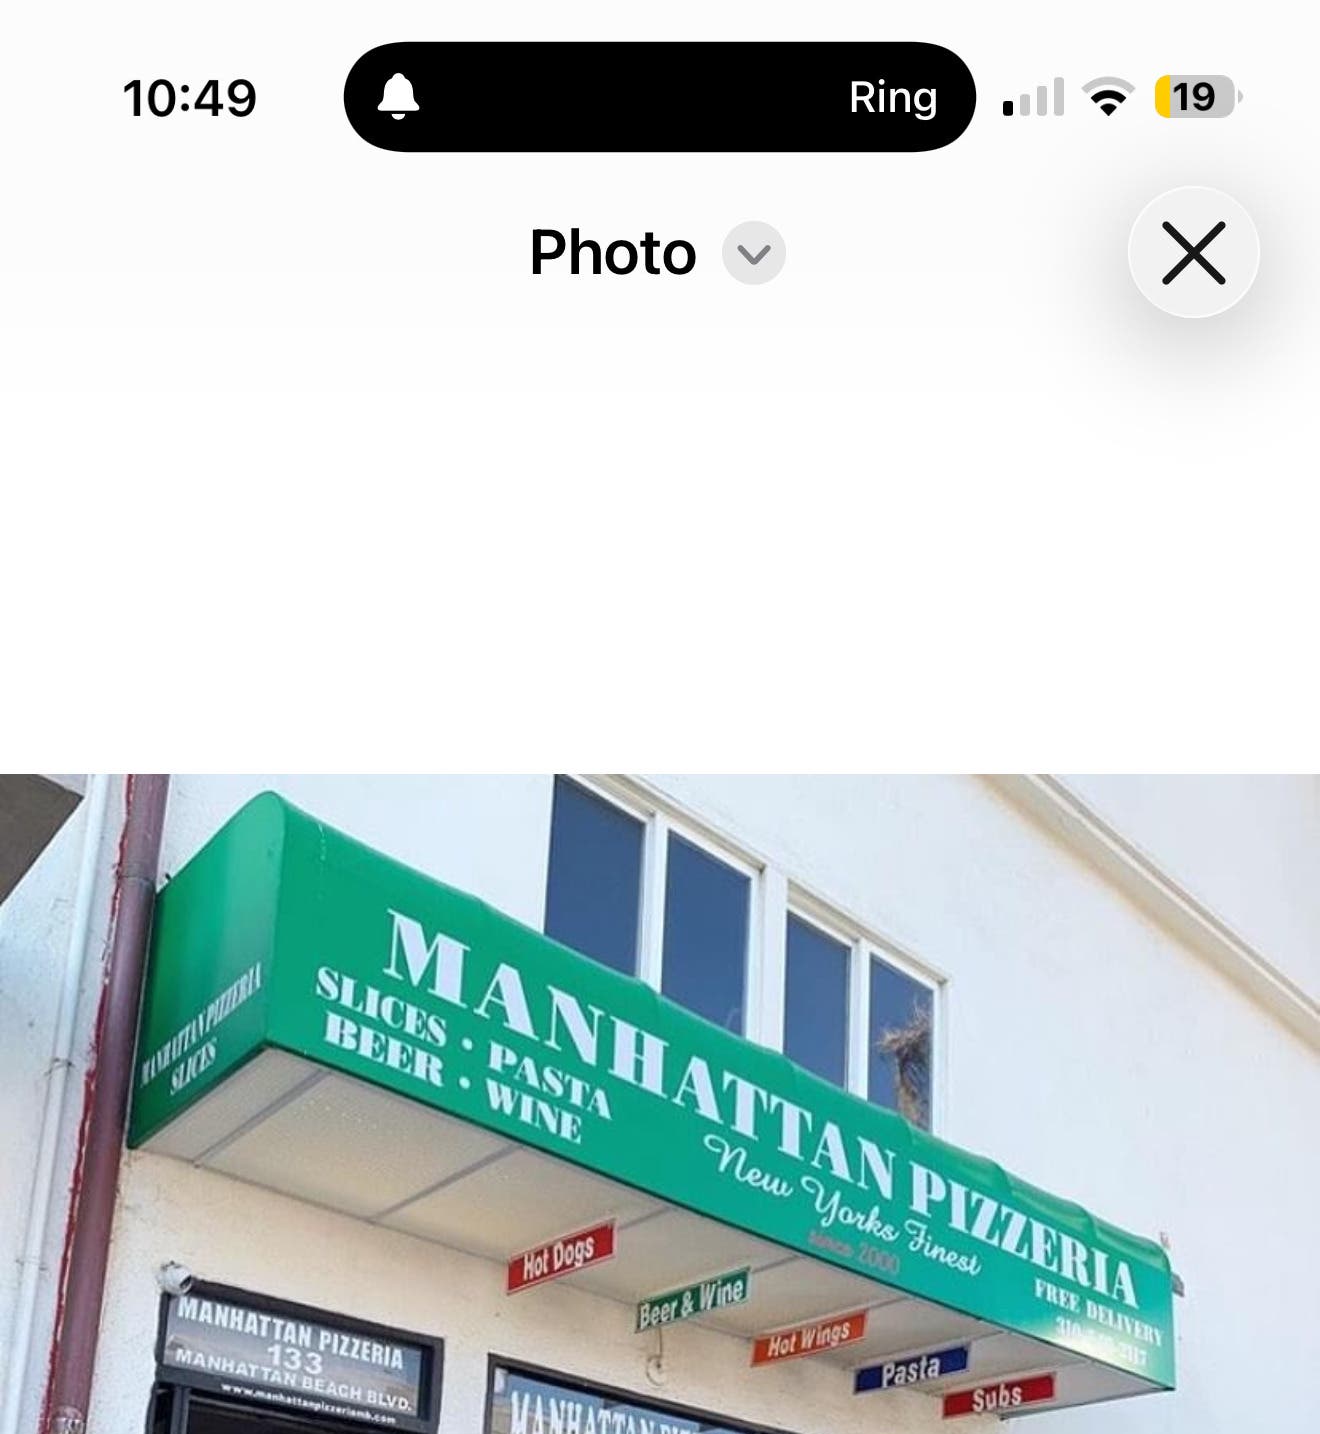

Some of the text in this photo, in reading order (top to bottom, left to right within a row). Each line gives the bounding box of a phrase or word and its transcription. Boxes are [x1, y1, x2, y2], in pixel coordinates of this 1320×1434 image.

[140, 1007, 206, 1088] MANHATTAN
[170, 1036, 217, 1095] SLICES
[315, 966, 612, 1120] SLICES PASTA
[323, 1011, 583, 1145] BEER WINE
[383, 908, 1140, 1310] MANHATTAN PIZZERIA
[703, 1133, 982, 1277] New Yorks Finest
[522, 1236, 595, 1282] Hot Dogs
[858, 1241, 901, 1277] 2000
[177, 1296, 404, 1371] MANHATTAN PIZZERIA
[639, 1279, 744, 1330] Beer & Wine
[1034, 1277, 1162, 1347] FREE DELIVERY
[267, 1344, 323, 1376] 133
[768, 1320, 851, 1358] Hot Wings
[175, 1347, 413, 1412] MANHATTAN BEACH BLVD.
[881, 1356, 941, 1388] Pasta
[971, 1384, 1022, 1413] Subs
